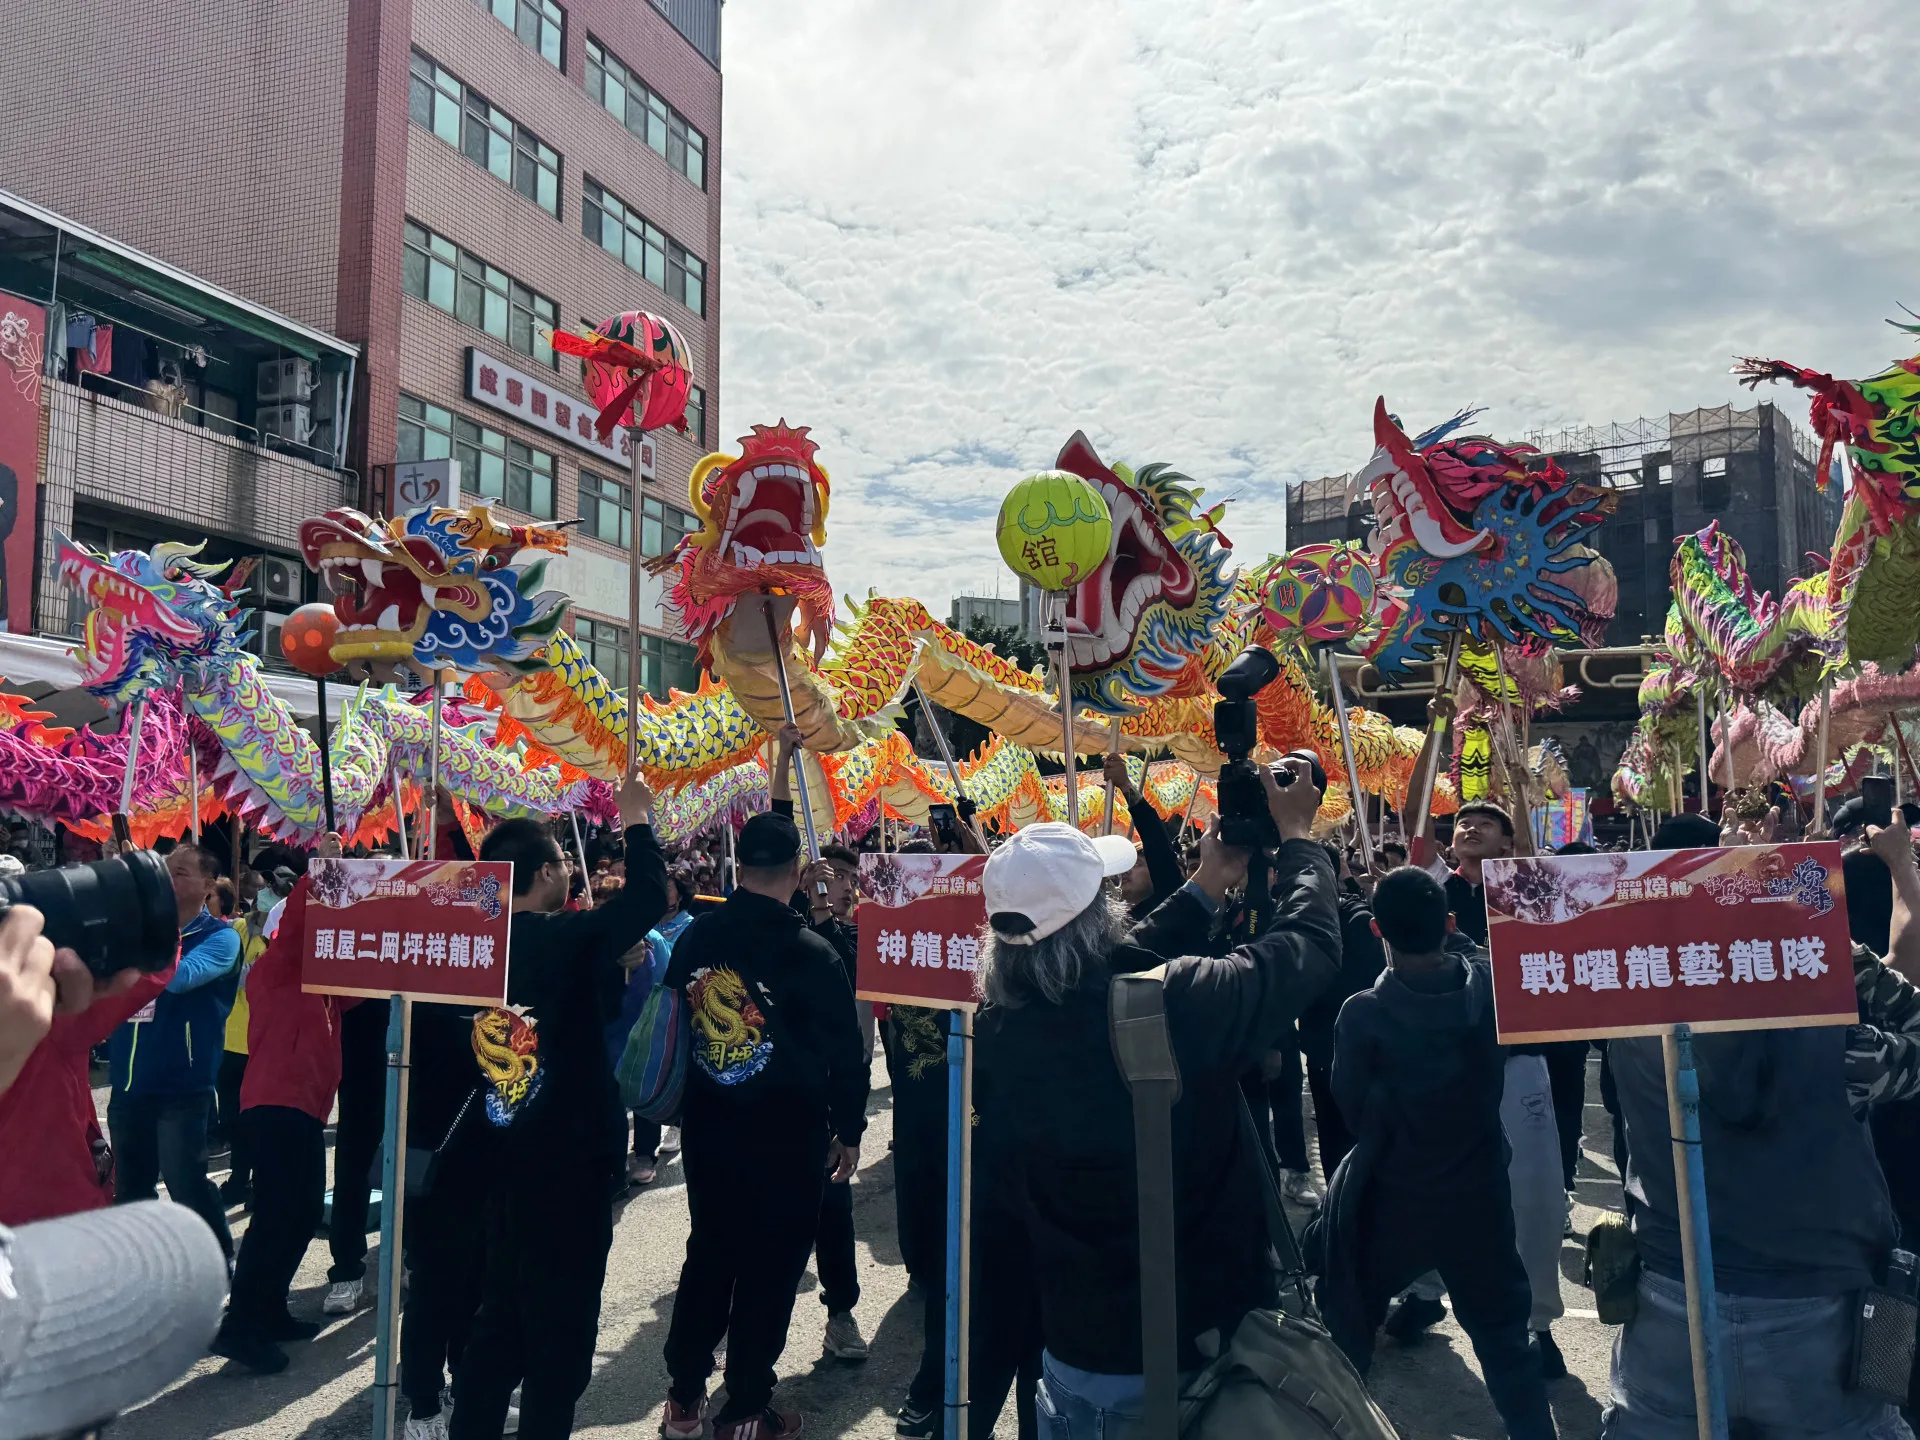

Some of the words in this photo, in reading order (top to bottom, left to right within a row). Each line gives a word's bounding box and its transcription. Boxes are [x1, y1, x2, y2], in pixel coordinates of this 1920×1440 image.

[1519, 935, 1830, 996] 戰曜龍藝龍隊
